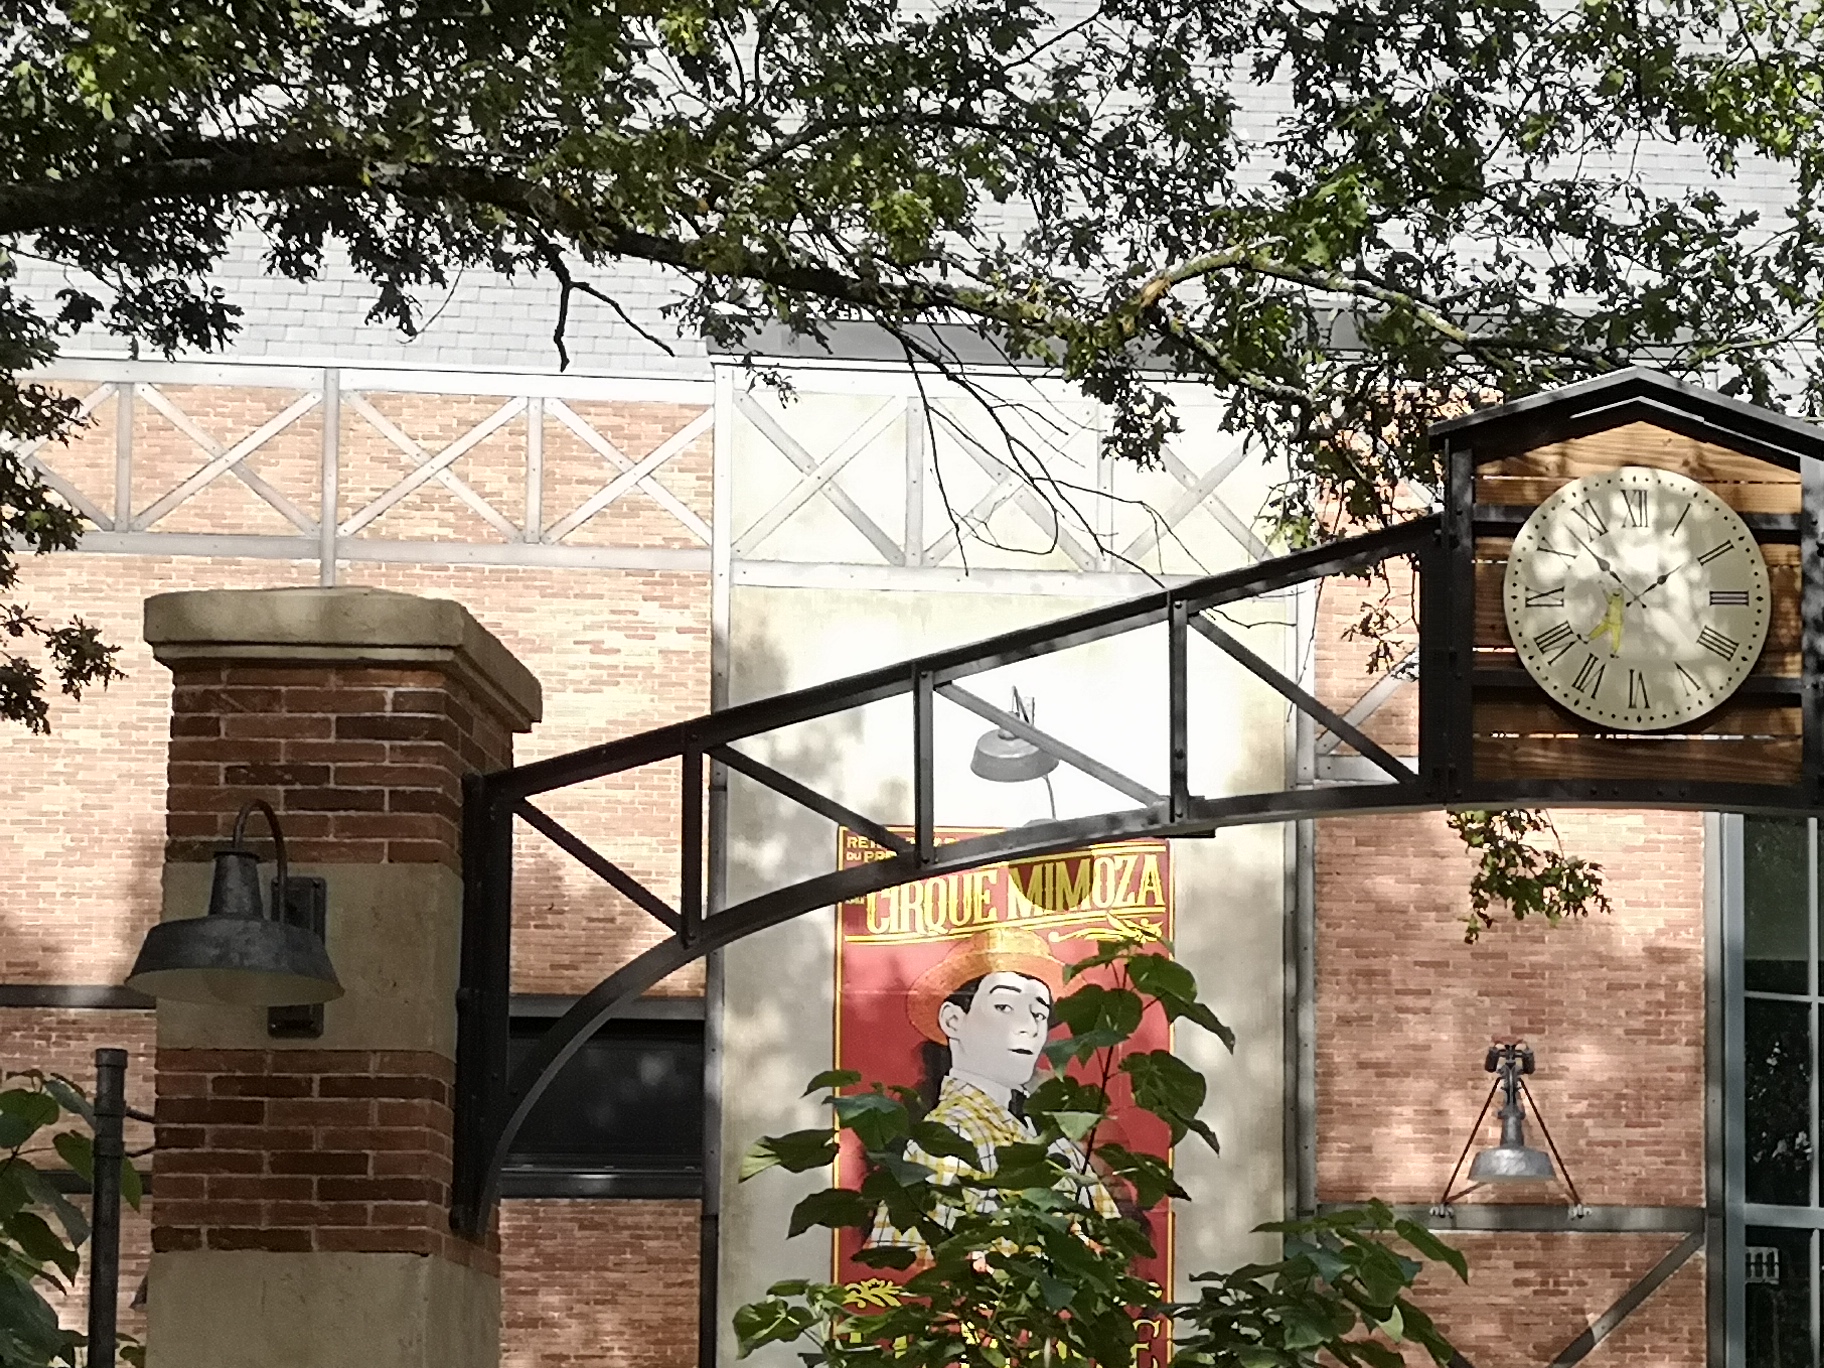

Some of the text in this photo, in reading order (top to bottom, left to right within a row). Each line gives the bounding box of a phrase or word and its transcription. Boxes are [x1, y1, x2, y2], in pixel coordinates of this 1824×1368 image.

[1571, 499, 1609, 542] XI
[1621, 489, 1648, 528] XII
[1671, 503, 1691, 536] I
[1697, 540, 1735, 565] II
[1709, 591, 1749, 605] III
[1533, 621, 1579, 665] VIII
[1571, 653, 1606, 699] VII
[1628, 669, 1651, 709] VI
[1675, 662, 1701, 696] V
[866, 854, 1165, 936] CIRQUE MIMOZA
